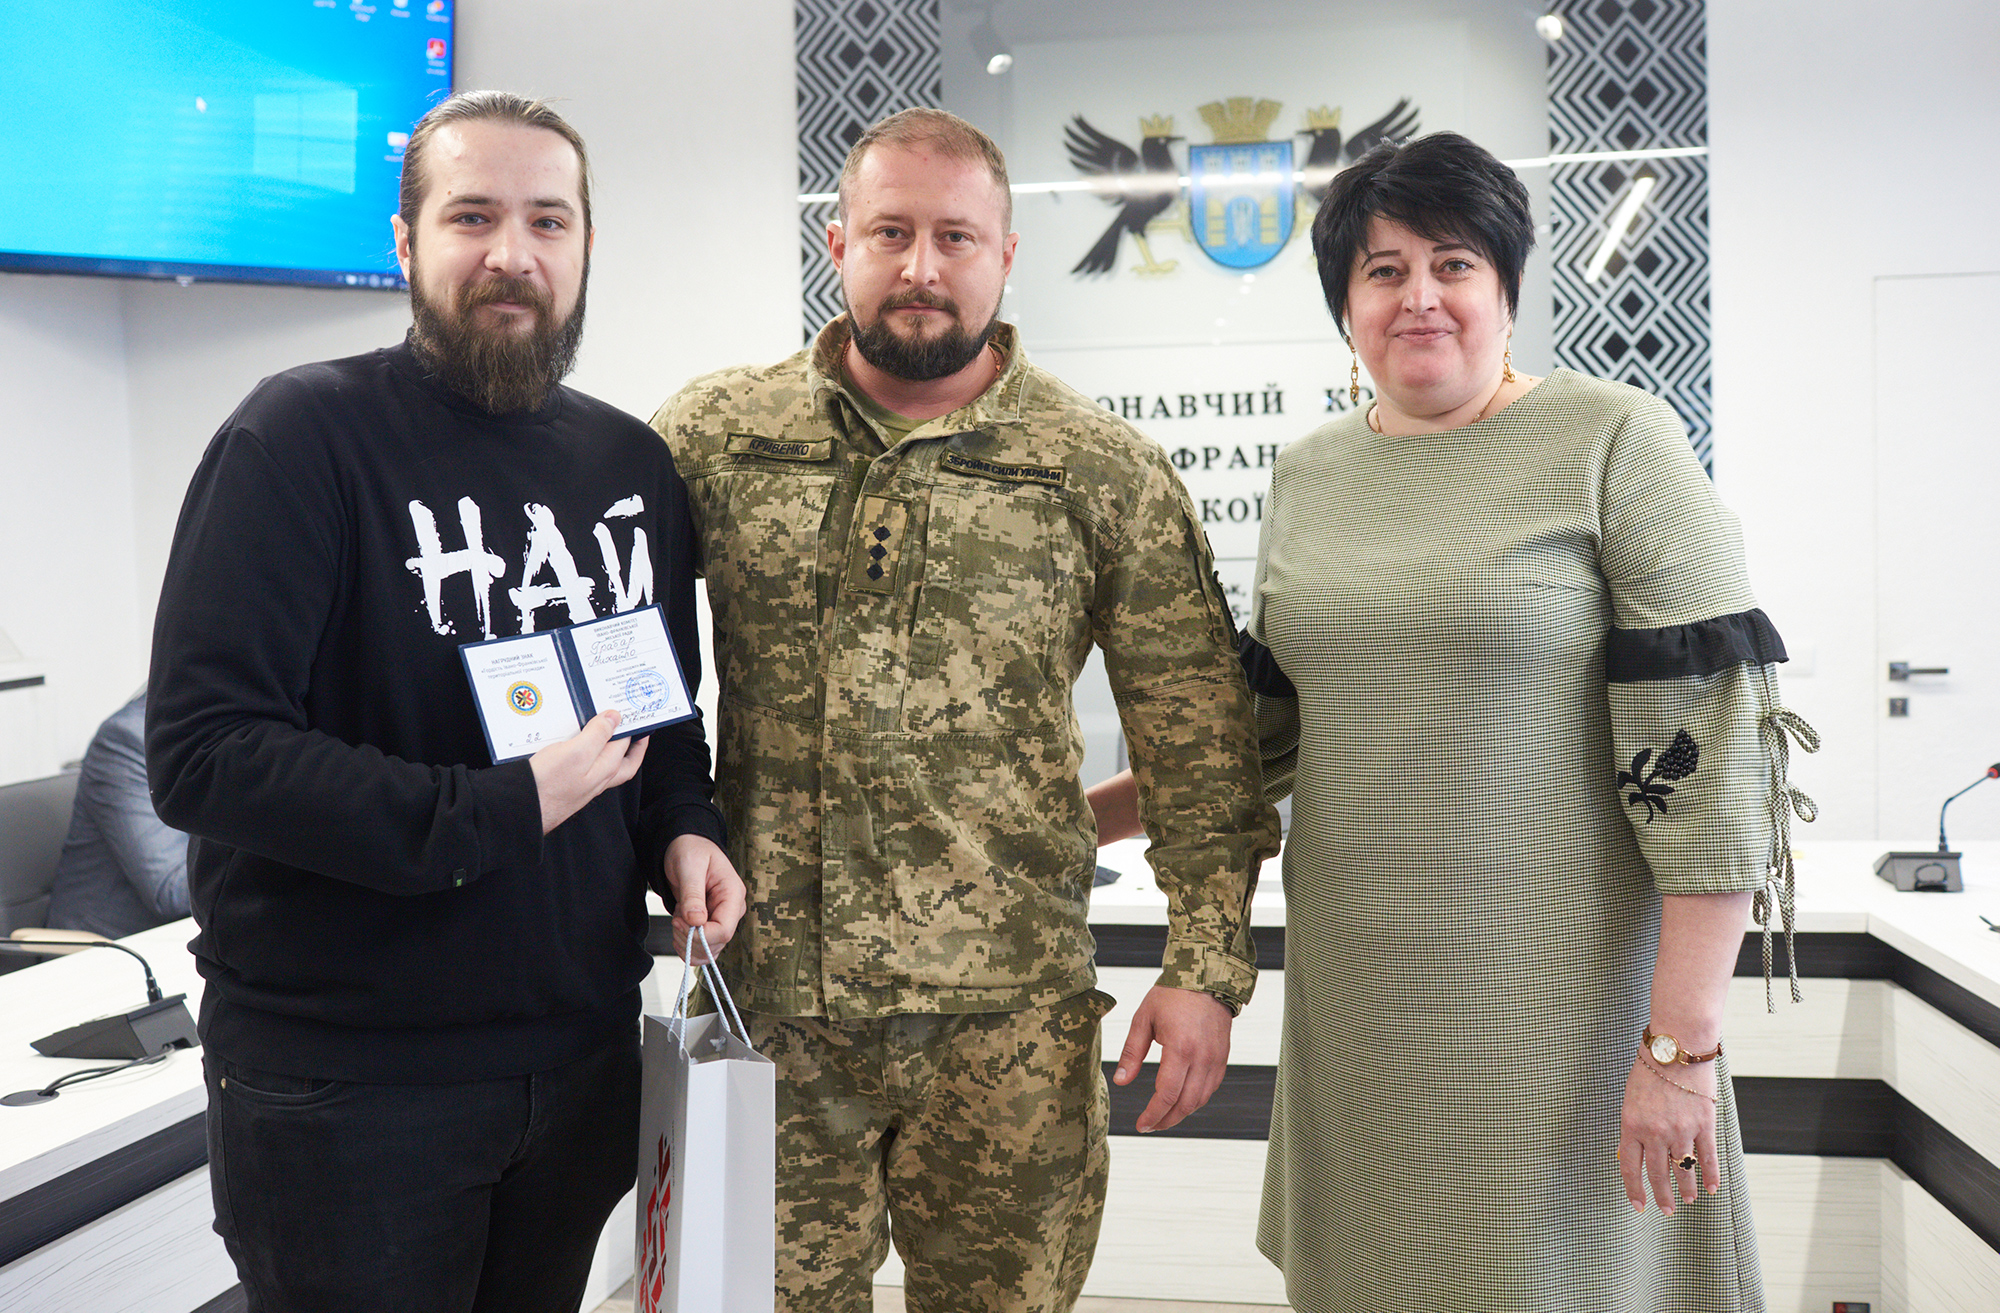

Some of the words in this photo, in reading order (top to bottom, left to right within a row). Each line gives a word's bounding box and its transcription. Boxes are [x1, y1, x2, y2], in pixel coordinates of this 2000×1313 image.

[749, 438, 809, 456] КРИВЕНКО
[947, 454, 991, 472] ЗБРОЙНІ
[991, 465, 1018, 476] СИЛИ
[1019, 467, 1061, 481] УКРАЇНИ
[405, 494, 654, 641] НАЙ
